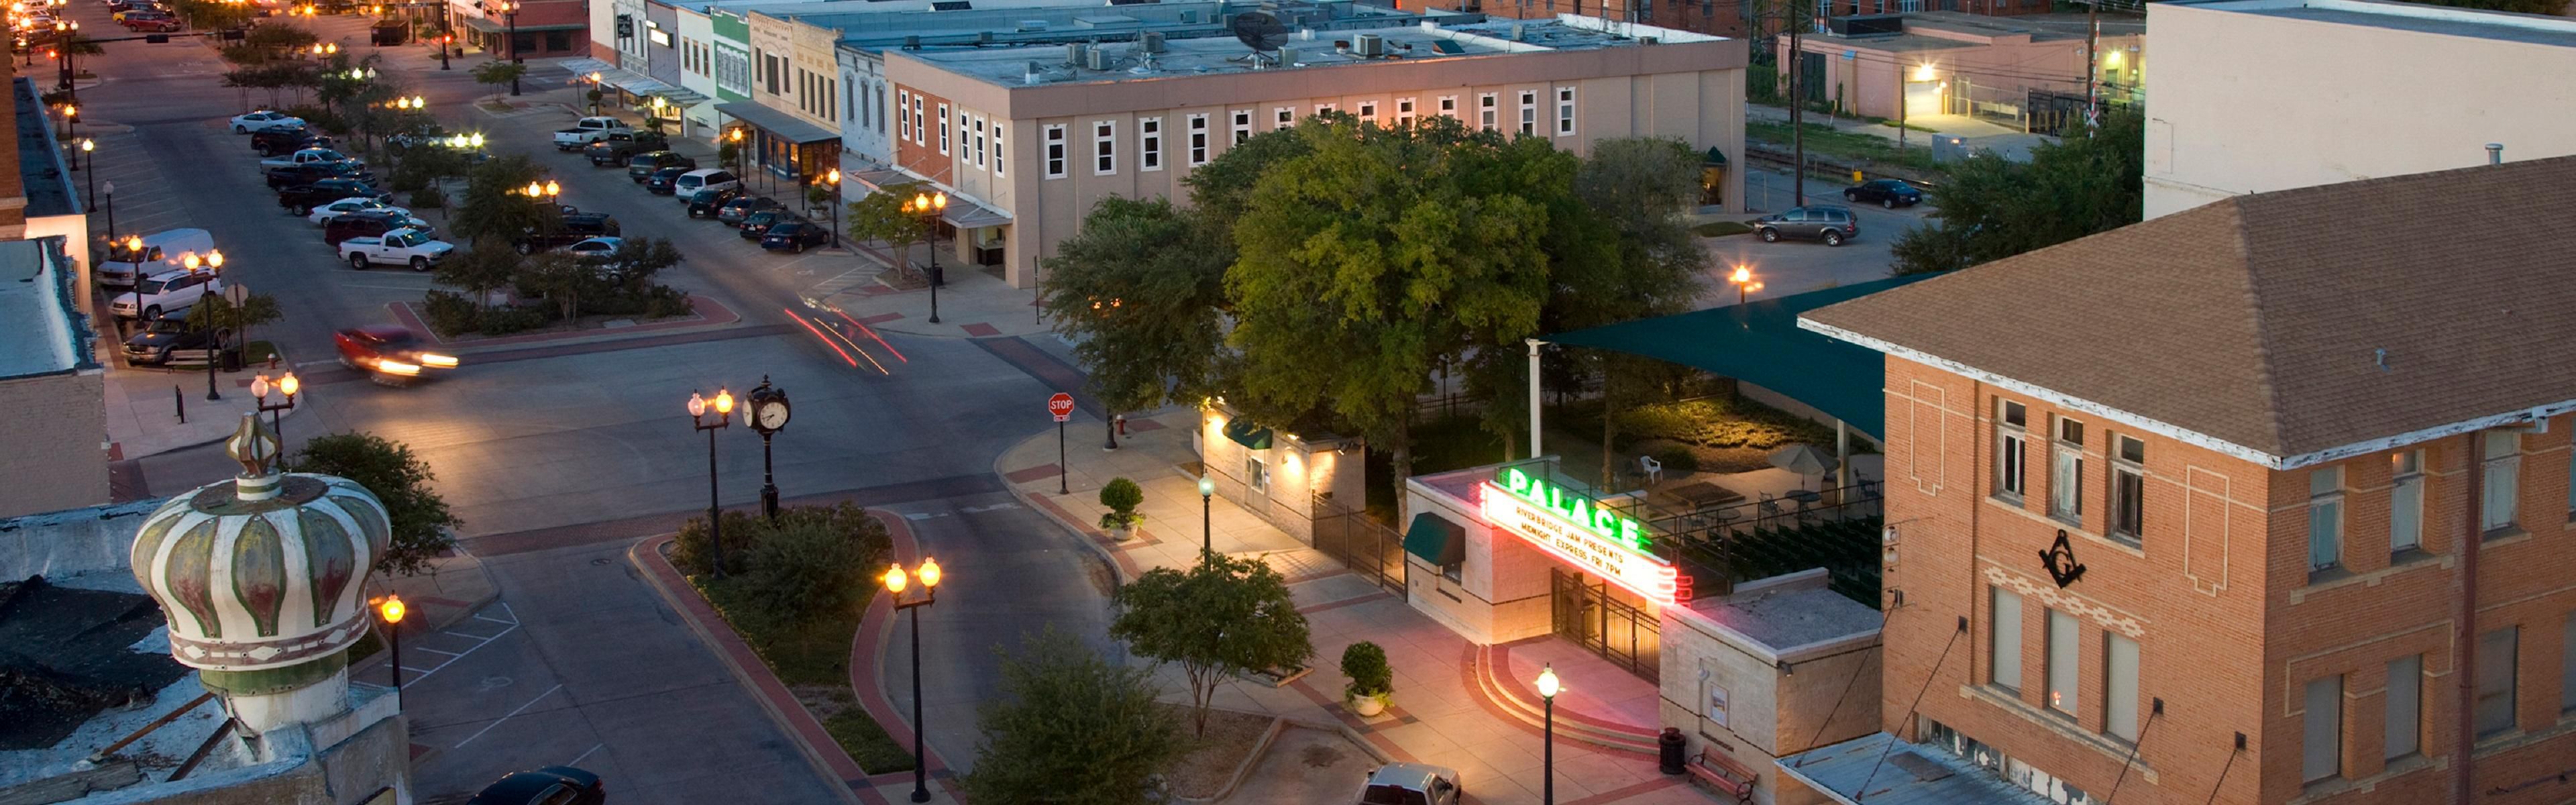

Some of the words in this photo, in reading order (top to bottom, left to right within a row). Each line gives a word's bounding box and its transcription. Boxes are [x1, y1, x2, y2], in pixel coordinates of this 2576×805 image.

[1051, 400, 1072, 409] STOP
[1509, 468, 1640, 550] PALACE
[1521, 523, 1551, 542] MIDNIGHT
[1556, 539, 1587, 560] EXPRESS
[1591, 555, 1603, 568] FRI
[1605, 561, 1621, 577] 7PM
[1566, 531, 1580, 543] JAM
[1584, 538, 1623, 564] PRESENTS
[2053, 551, 2071, 576] G
